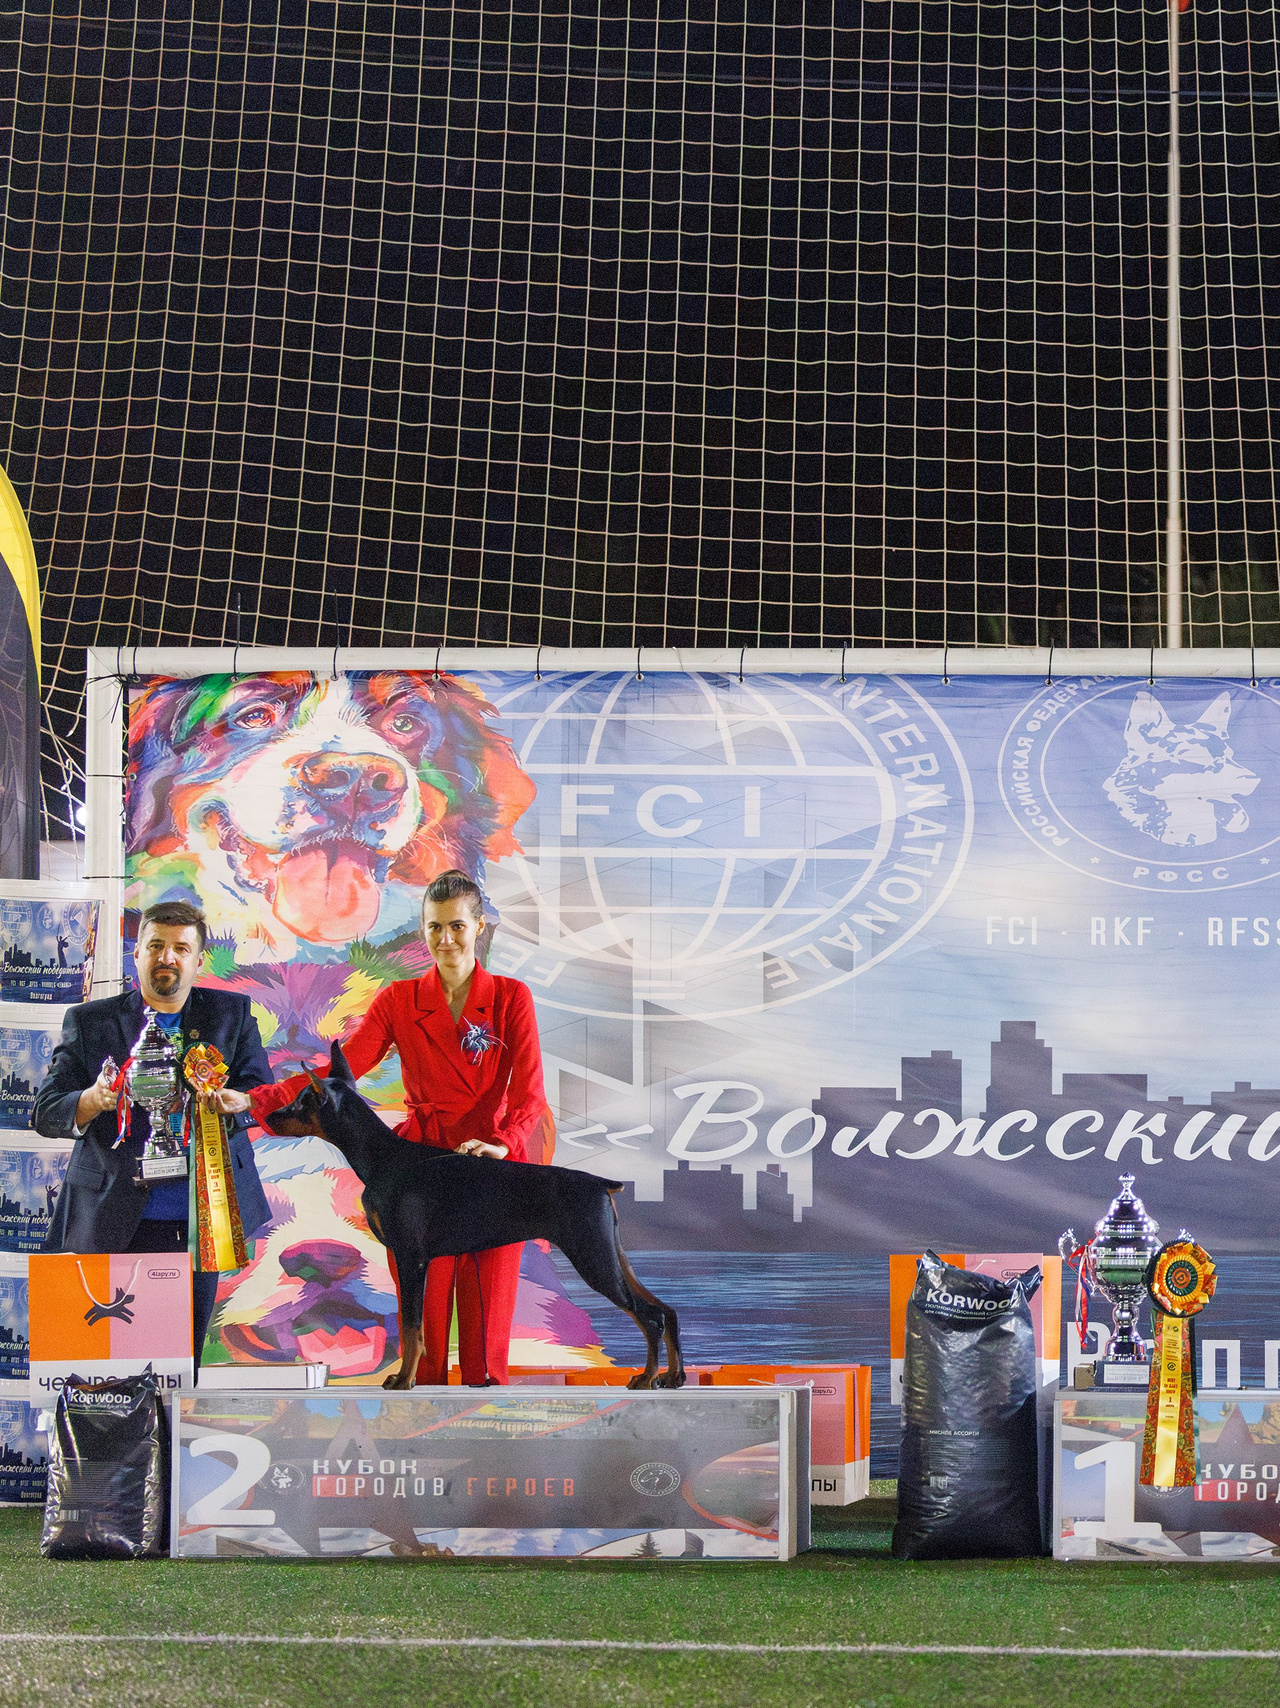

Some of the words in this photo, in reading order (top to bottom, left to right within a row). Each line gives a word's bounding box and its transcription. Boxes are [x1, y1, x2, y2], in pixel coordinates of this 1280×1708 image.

[1011, 736, 1070, 847] РОССИЙСКАЯ
[560, 784, 762, 838] FCI
[1133, 866, 1230, 883] РФСС
[985, 916, 1039, 946] FCI
[1090, 916, 1154, 947] RKF
[70, 1392, 132, 1404] KORWOOD
[186, 1433, 276, 1526] 2
[312, 1459, 418, 1475] КУБОК
[316, 1476, 445, 1499] ГОРОДОВ
[467, 1477, 575, 1497] ГЕРОЕВ
[1073, 1440, 1163, 1539] 1
